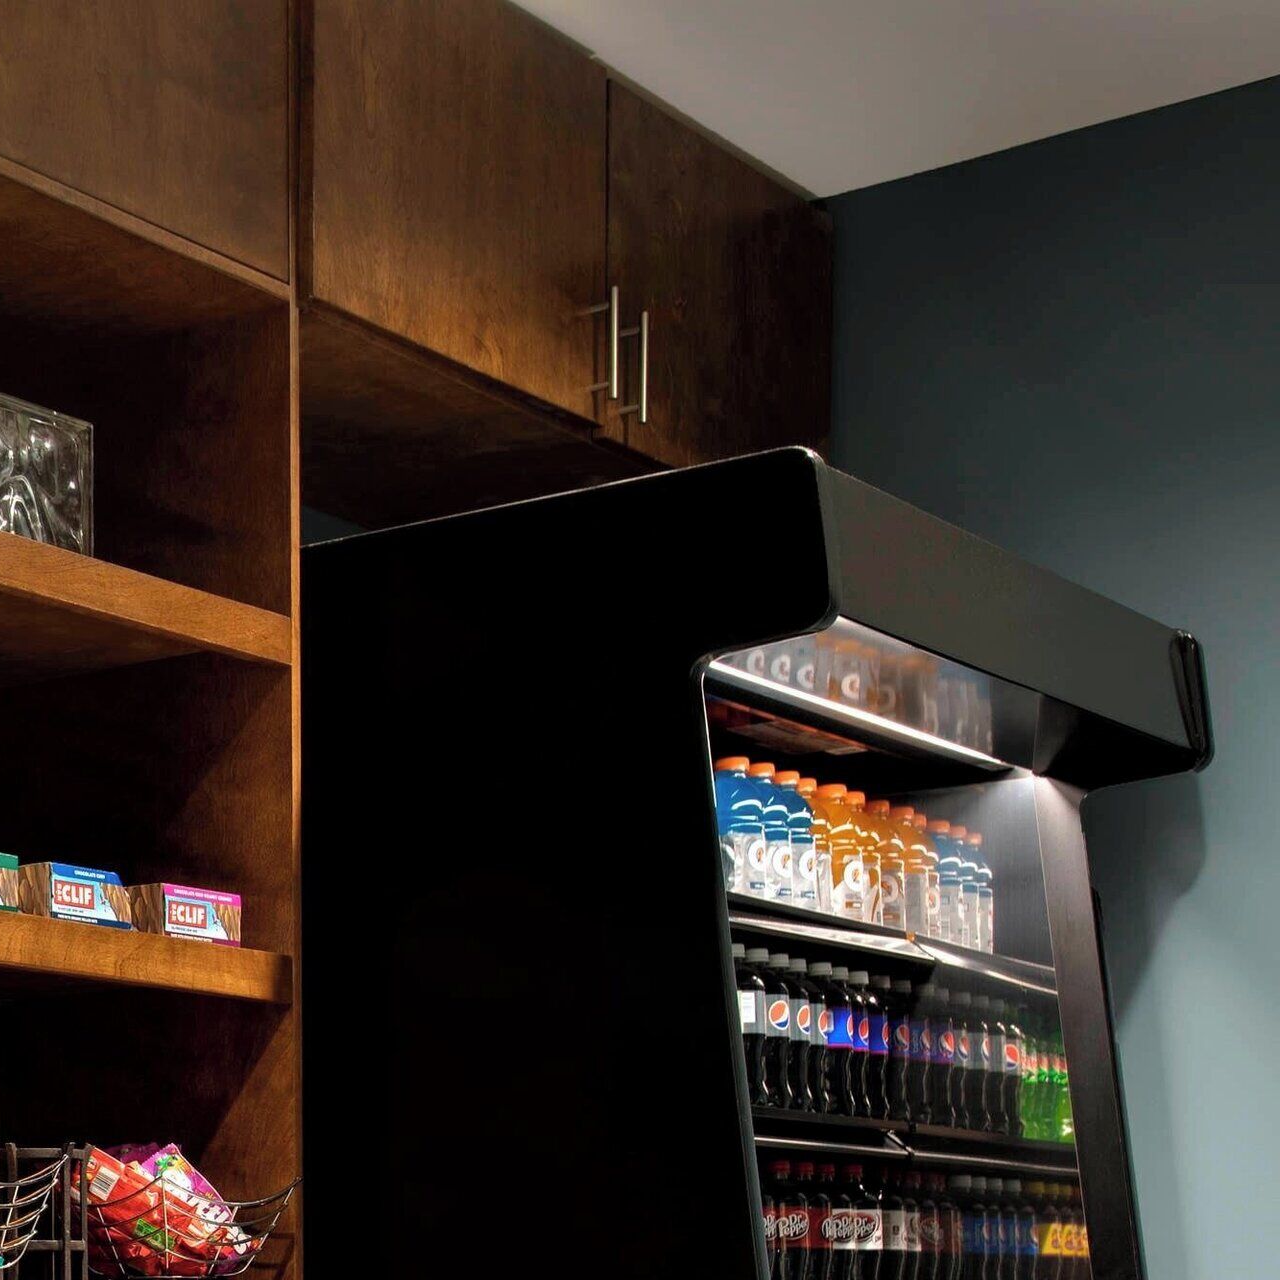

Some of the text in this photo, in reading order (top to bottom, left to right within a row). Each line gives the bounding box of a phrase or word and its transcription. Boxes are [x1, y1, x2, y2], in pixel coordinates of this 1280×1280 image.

[74, 869, 95, 879] CHOCOLATE
[61, 884, 93, 906] CLIF
[176, 904, 206, 927] CLIF
